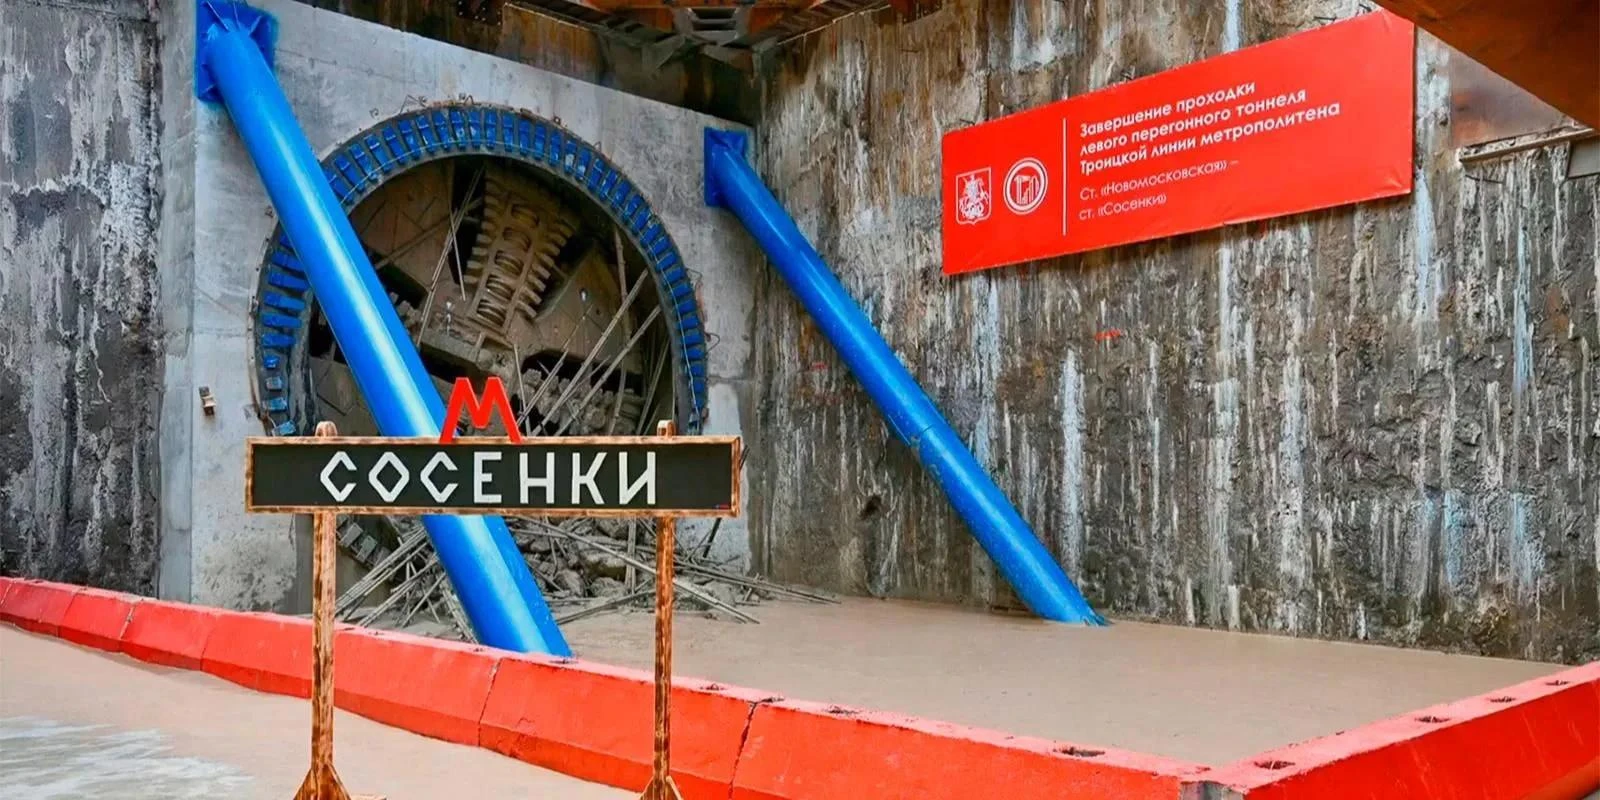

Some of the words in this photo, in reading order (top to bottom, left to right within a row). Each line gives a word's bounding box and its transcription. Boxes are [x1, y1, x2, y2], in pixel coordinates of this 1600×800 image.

[1080, 103, 1172, 138] Завершение
[1176, 82, 1256, 113] проходки
[1080, 134, 1128, 157] левого
[1131, 108, 1231, 143] перегонного
[1236, 89, 1307, 117] тоннеля
[1080, 144, 1148, 176] Троицкой
[1151, 136, 1196, 158] линии
[1200, 102, 1341, 146] метрополитена
[1078, 209, 1095, 221] ст.
[1098, 193, 1167, 217] «Сосенки»
[1079, 187, 1098, 201] Ст.
[319, 450, 657, 505] СОСЕНКИ
